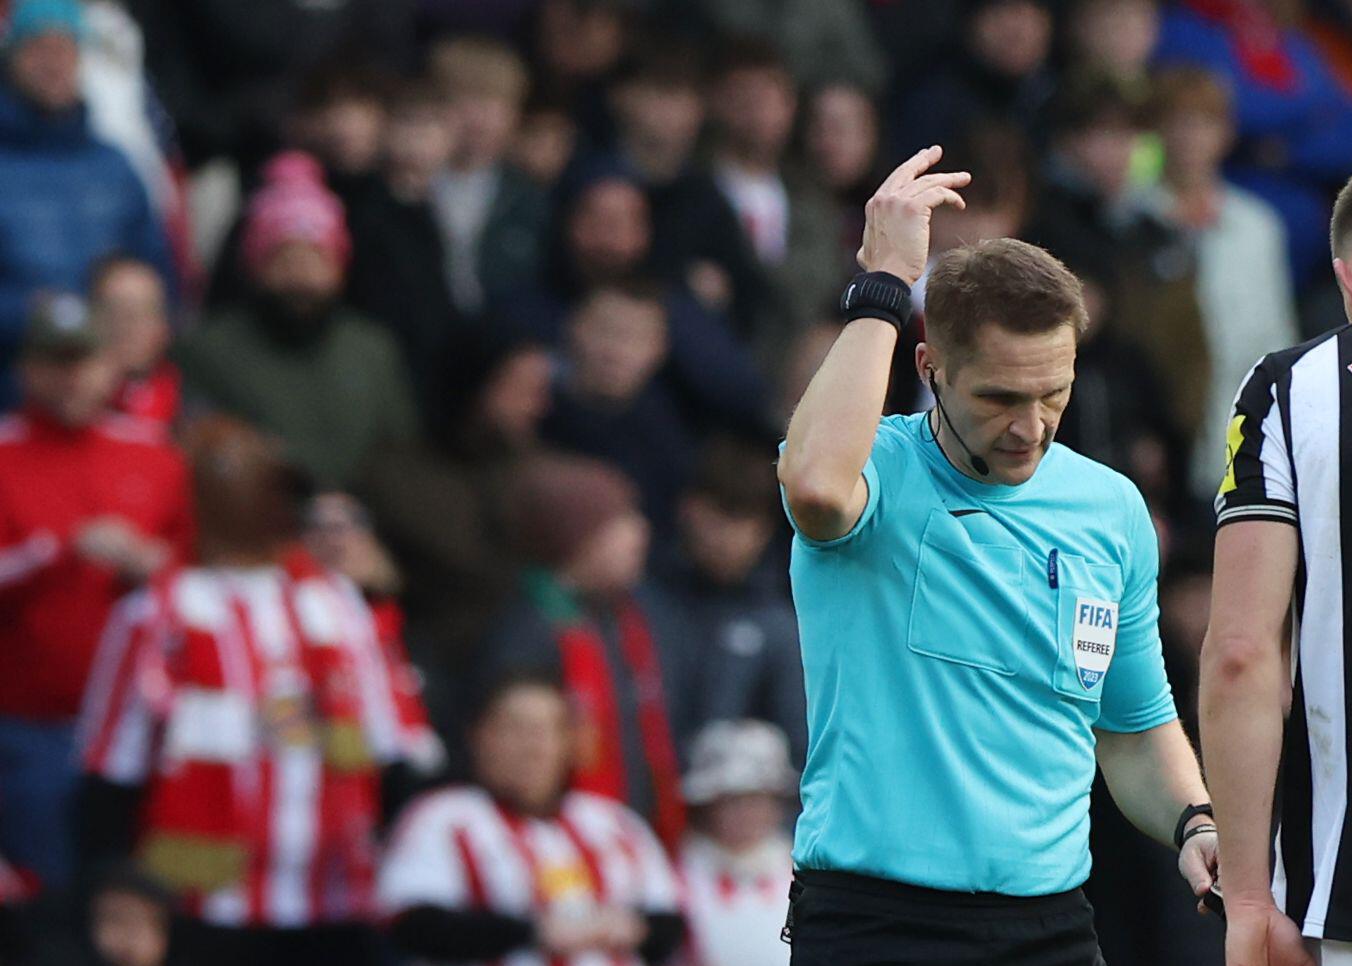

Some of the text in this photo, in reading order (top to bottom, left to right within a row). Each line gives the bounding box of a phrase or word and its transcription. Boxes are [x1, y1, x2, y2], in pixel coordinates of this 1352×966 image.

[1079, 603, 1112, 628] FIFA
[1077, 639, 1110, 655] REFEREE
[1083, 670, 1098, 682] 2023
